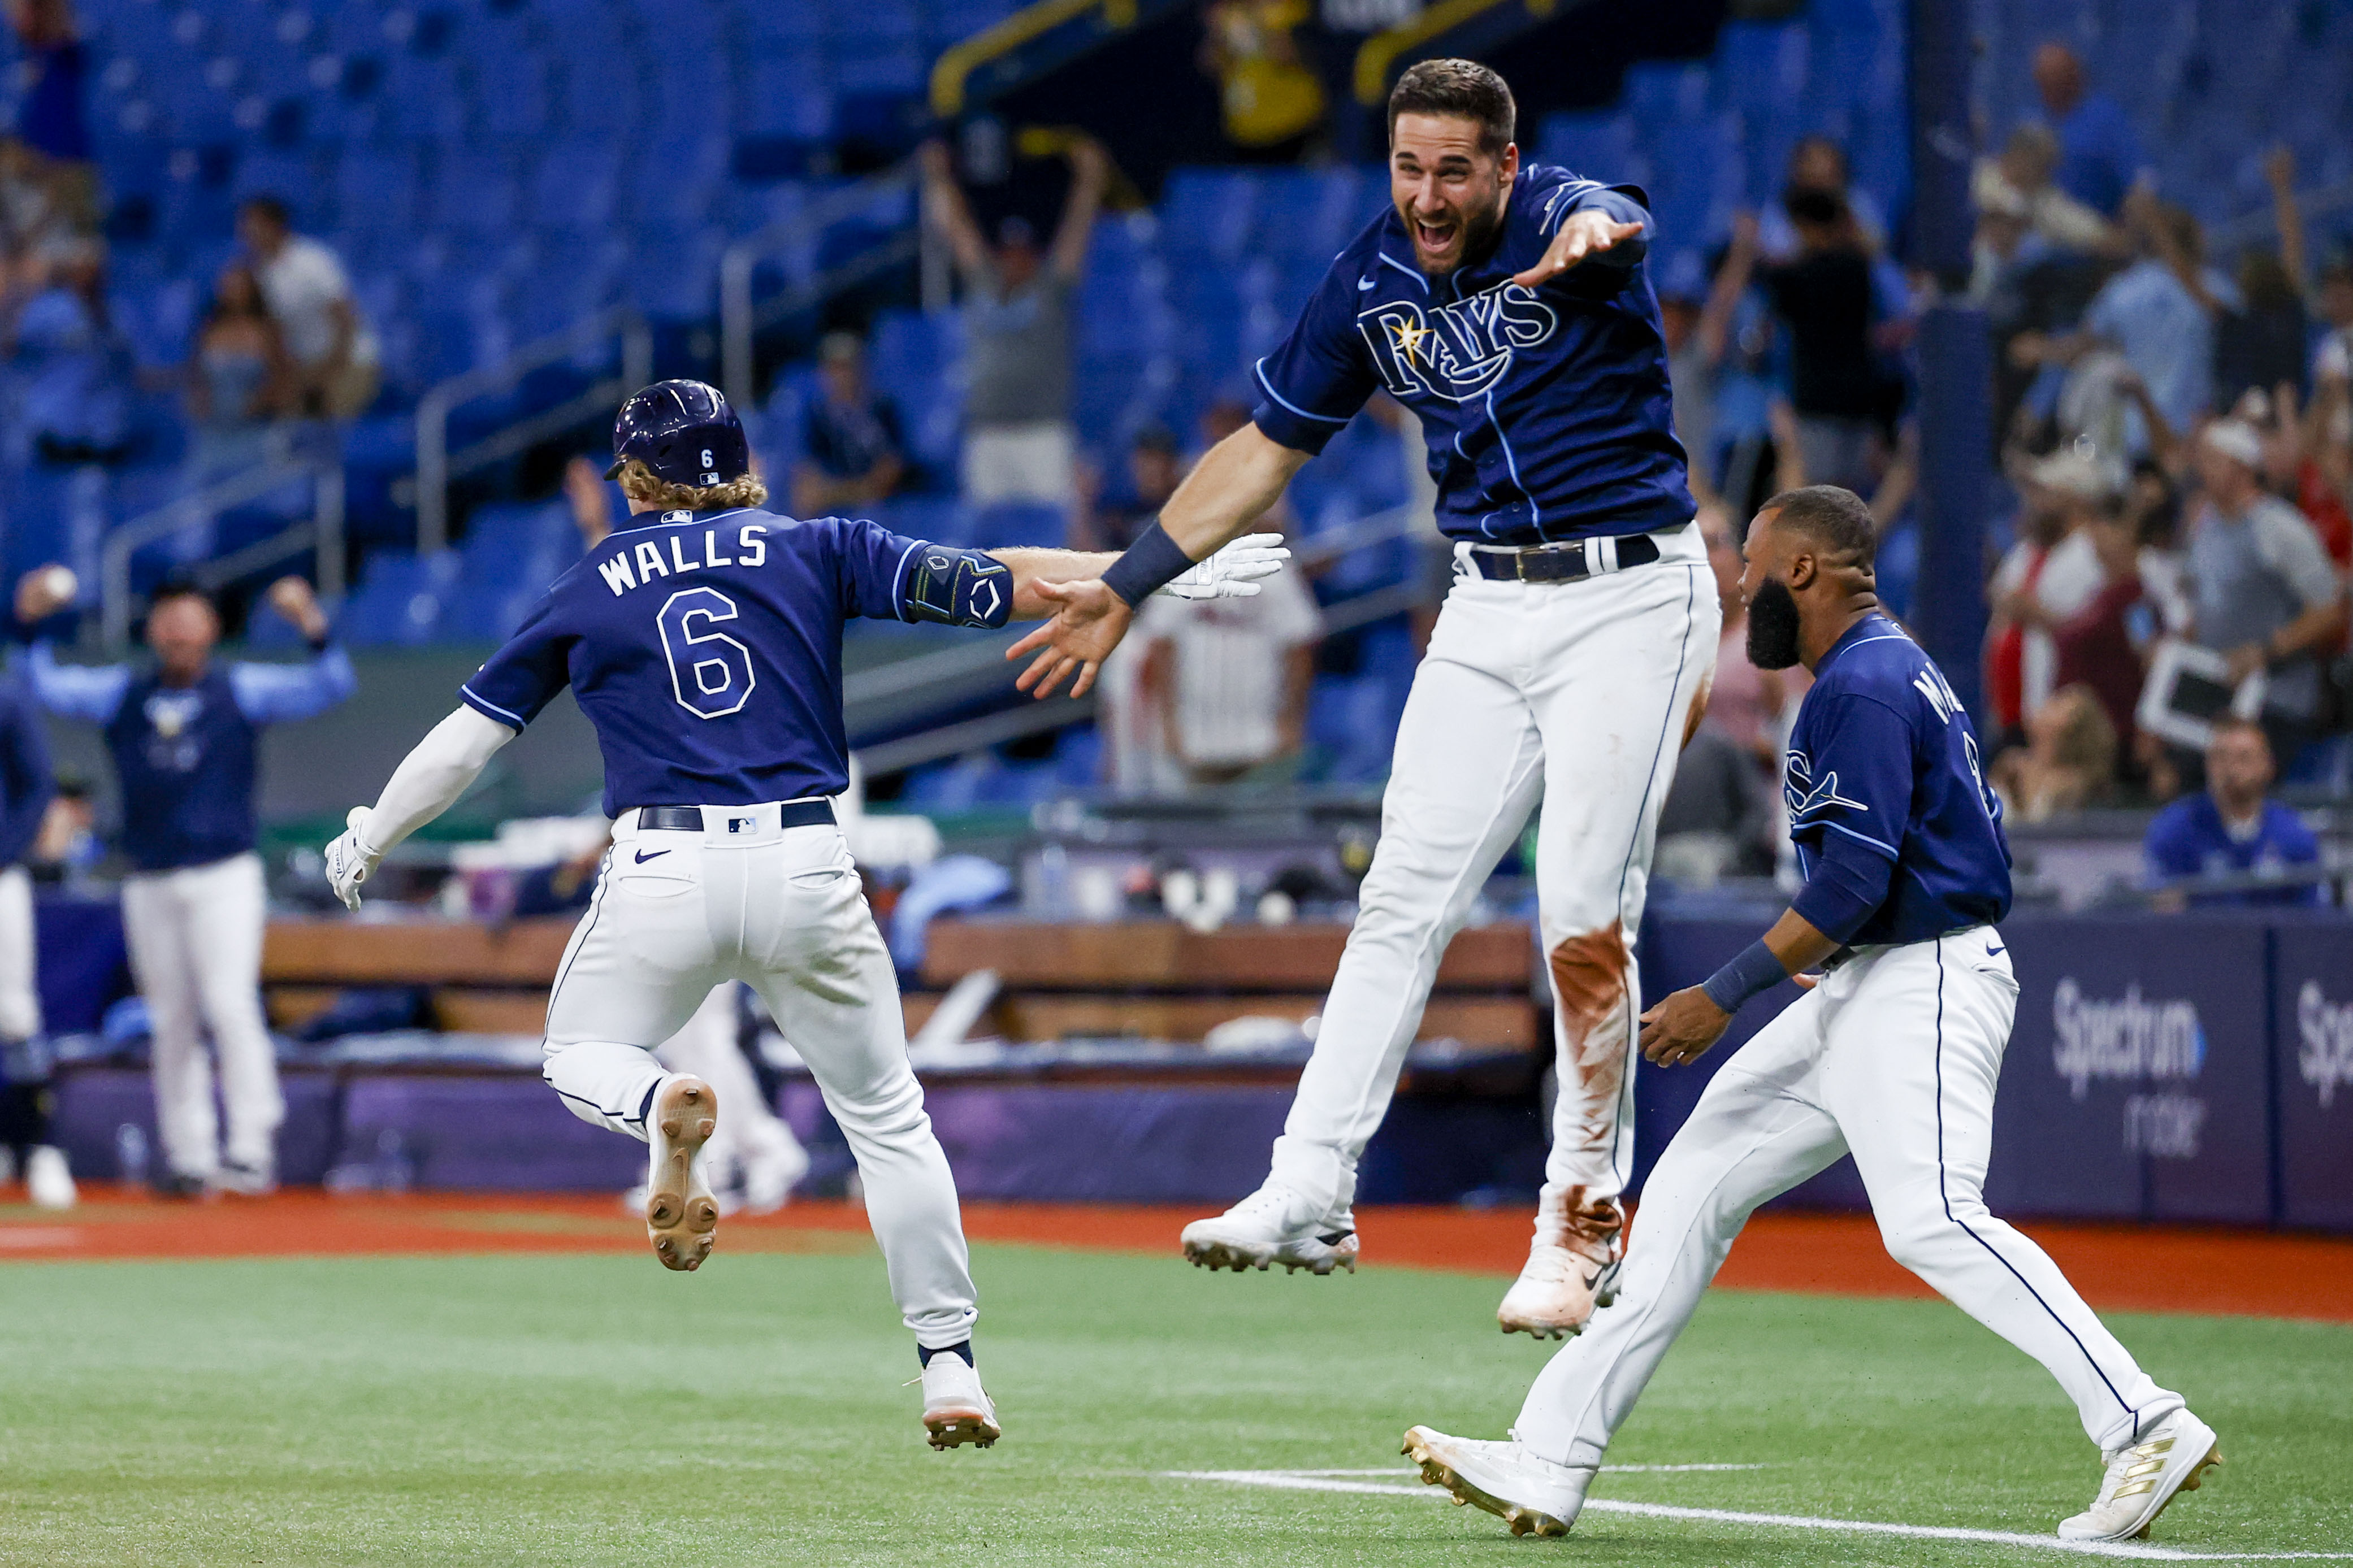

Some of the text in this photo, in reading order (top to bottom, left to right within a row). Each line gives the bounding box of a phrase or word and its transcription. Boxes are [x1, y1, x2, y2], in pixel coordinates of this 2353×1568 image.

[701, 449, 713, 468] 6
[597, 525, 767, 597] WALLS
[656, 586, 756, 719] 6
